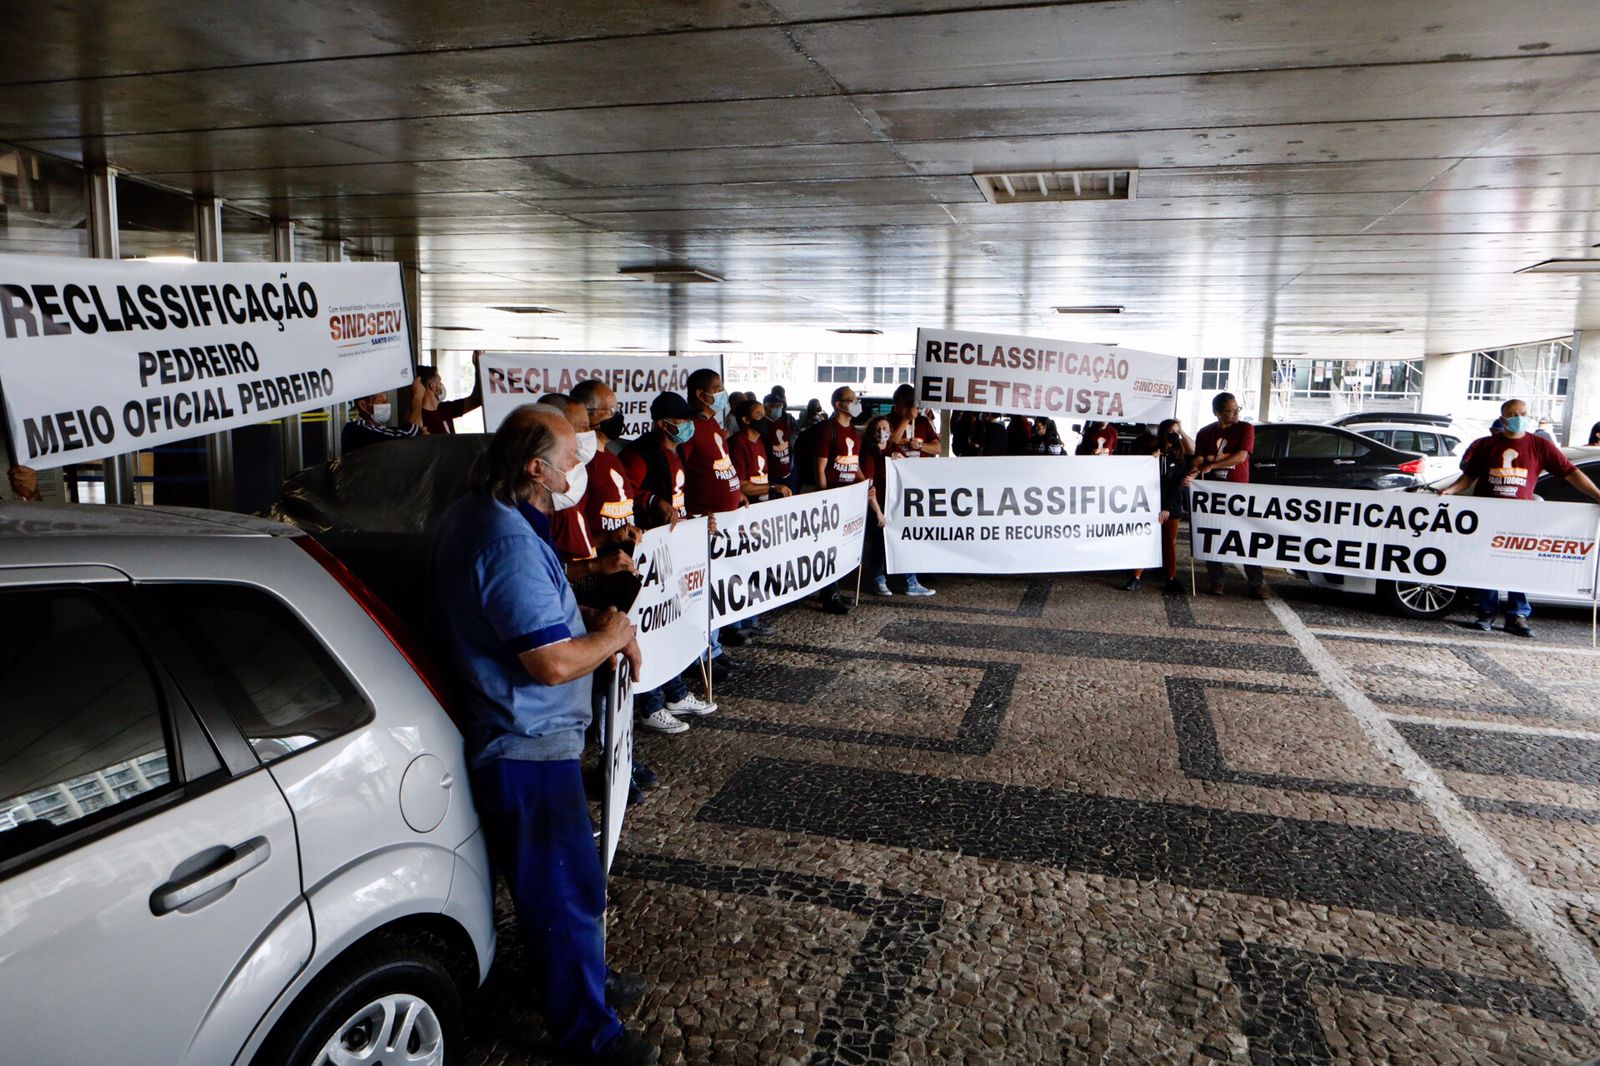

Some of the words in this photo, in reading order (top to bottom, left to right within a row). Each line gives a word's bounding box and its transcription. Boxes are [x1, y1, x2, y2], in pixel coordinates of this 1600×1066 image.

[1, 272, 319, 338] RECLASSIFICAÇÃO
[329, 309, 402, 341] SINDSERV
[139, 341, 260, 387] PEDREIRO
[925, 340, 1129, 383] RECLASSIFICAÇÃO
[23, 405, 115, 459] MEIO
[123, 388, 235, 434] OFICIAL
[237, 367, 334, 415] PEDREIRO
[921, 376, 1124, 417] ELETRICISTA
[903, 485, 1152, 517] RECLASSIFICA
[1192, 491, 1479, 538] RECLASSIFICAÇÃO
[901, 526, 975, 541] AUXILIAR
[981, 526, 1000, 541] DE
[1005, 524, 1081, 541] RECURSOS
[1086, 522, 1152, 538] HUMANOS
[1197, 526, 1447, 577] TAPECEIRO
[1491, 535, 1595, 555] SINDSERV
[710, 546, 838, 620] NCANADOR
